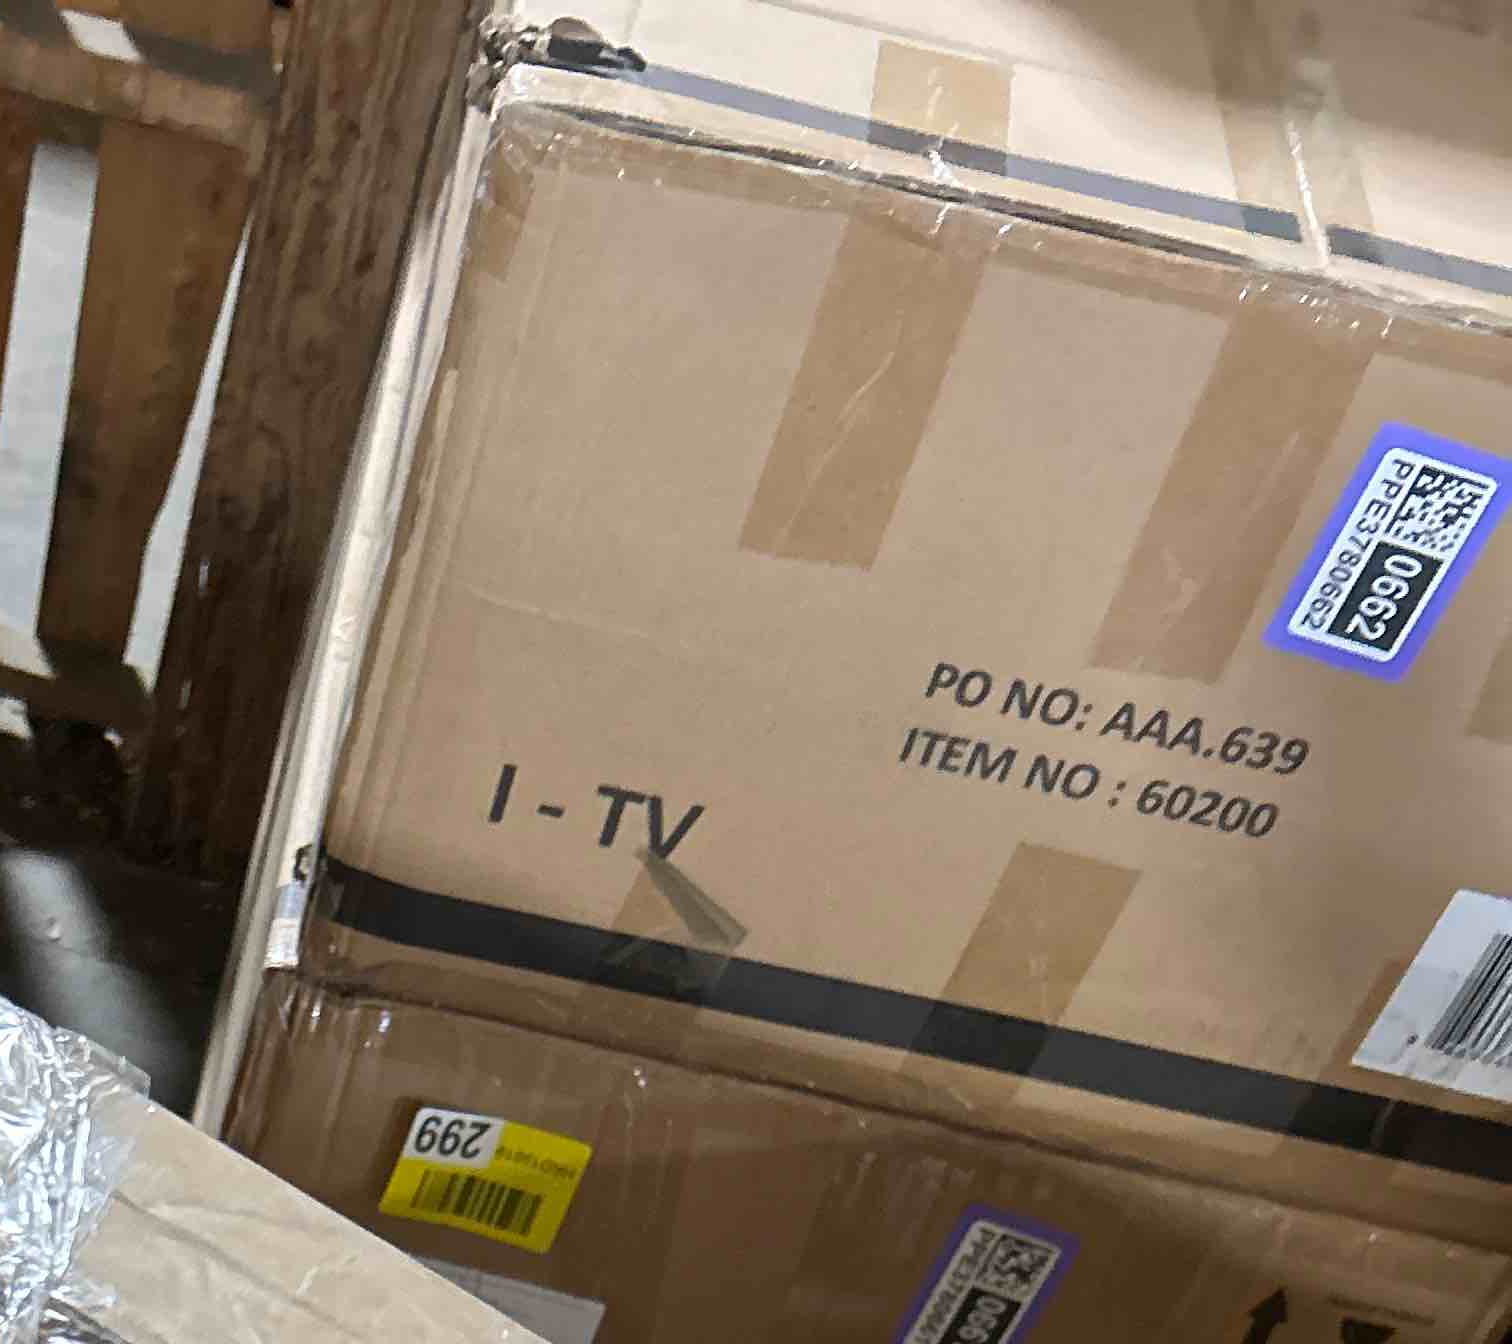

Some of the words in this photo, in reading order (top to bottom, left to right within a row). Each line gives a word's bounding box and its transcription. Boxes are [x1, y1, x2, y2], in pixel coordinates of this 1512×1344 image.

[1299, 458, 1416, 630] PPE3780662
[1345, 554, 1423, 642] 0662
[925, 662, 992, 708] PO
[1000, 679, 1093, 731] NO:
[1098, 702, 1310, 776] AAA.639
[597, 785, 705, 859] TV
[899, 727, 1018, 784] ITEM
[1024, 754, 1101, 800] NO
[1136, 779, 1279, 838] 60200
[415, 1115, 492, 1160] 299
